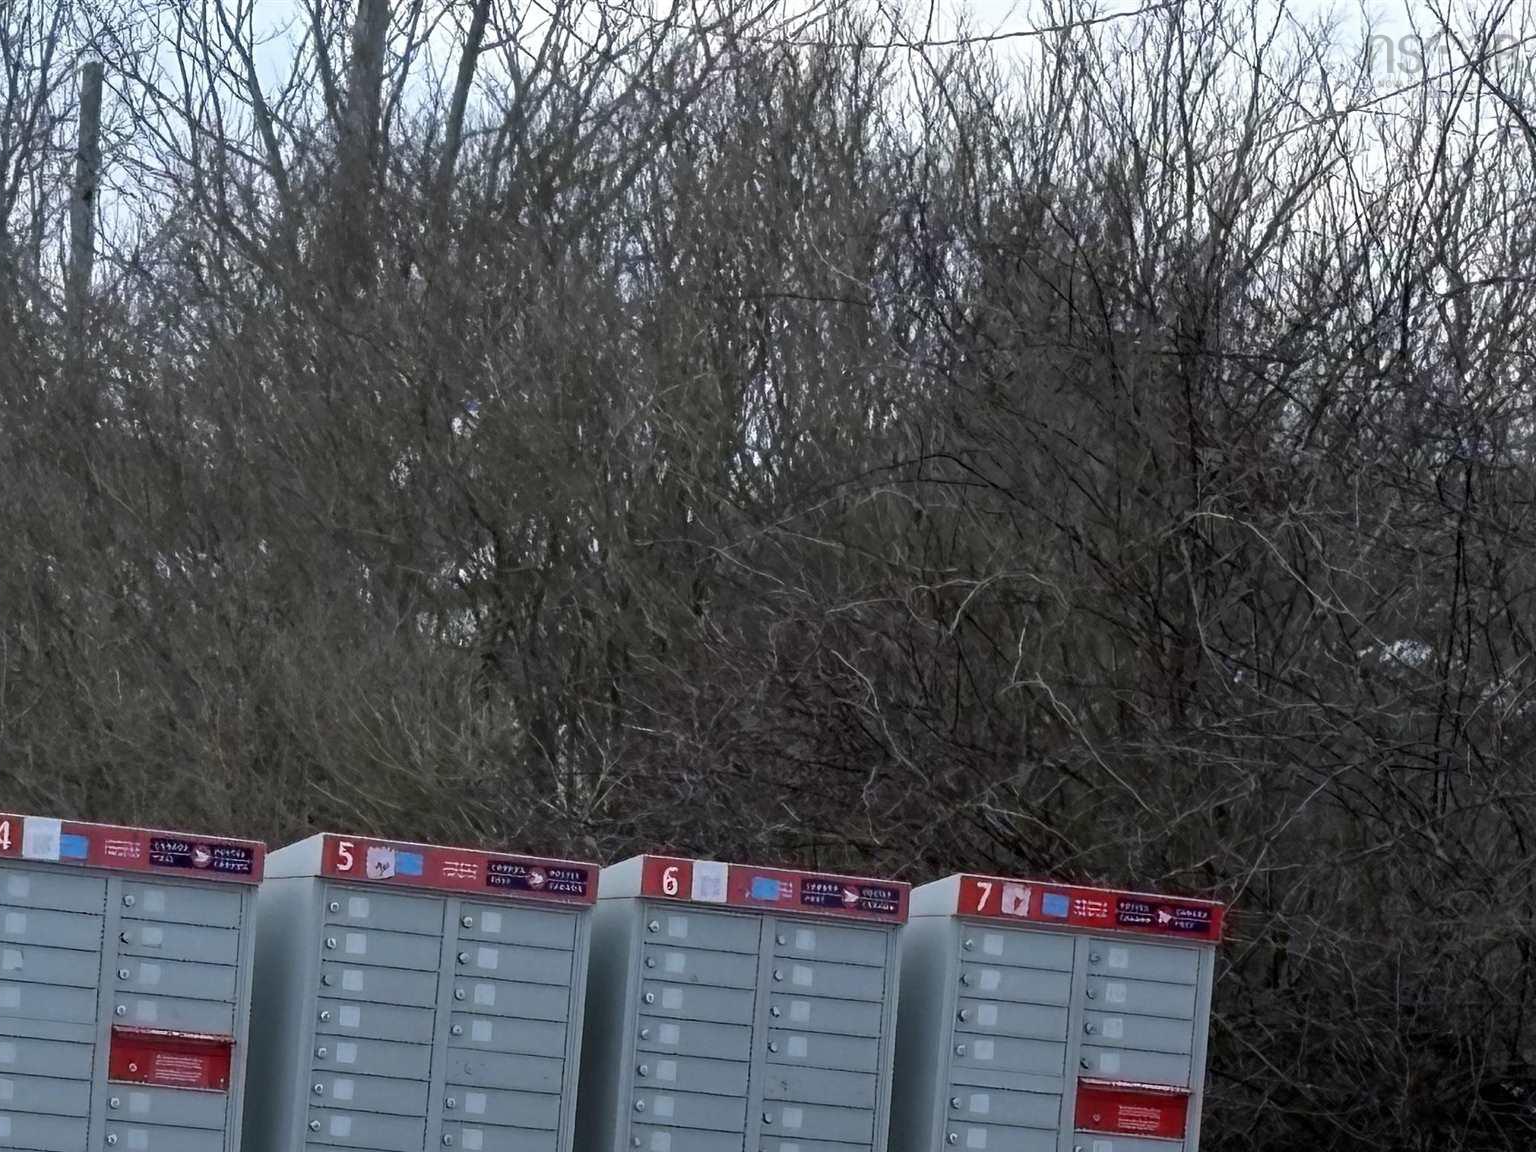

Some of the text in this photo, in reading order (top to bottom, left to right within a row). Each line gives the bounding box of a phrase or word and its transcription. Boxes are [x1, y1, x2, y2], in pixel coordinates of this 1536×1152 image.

[336, 841, 354, 873] 5
[662, 866, 679, 896] 6
[976, 881, 994, 912] 7
